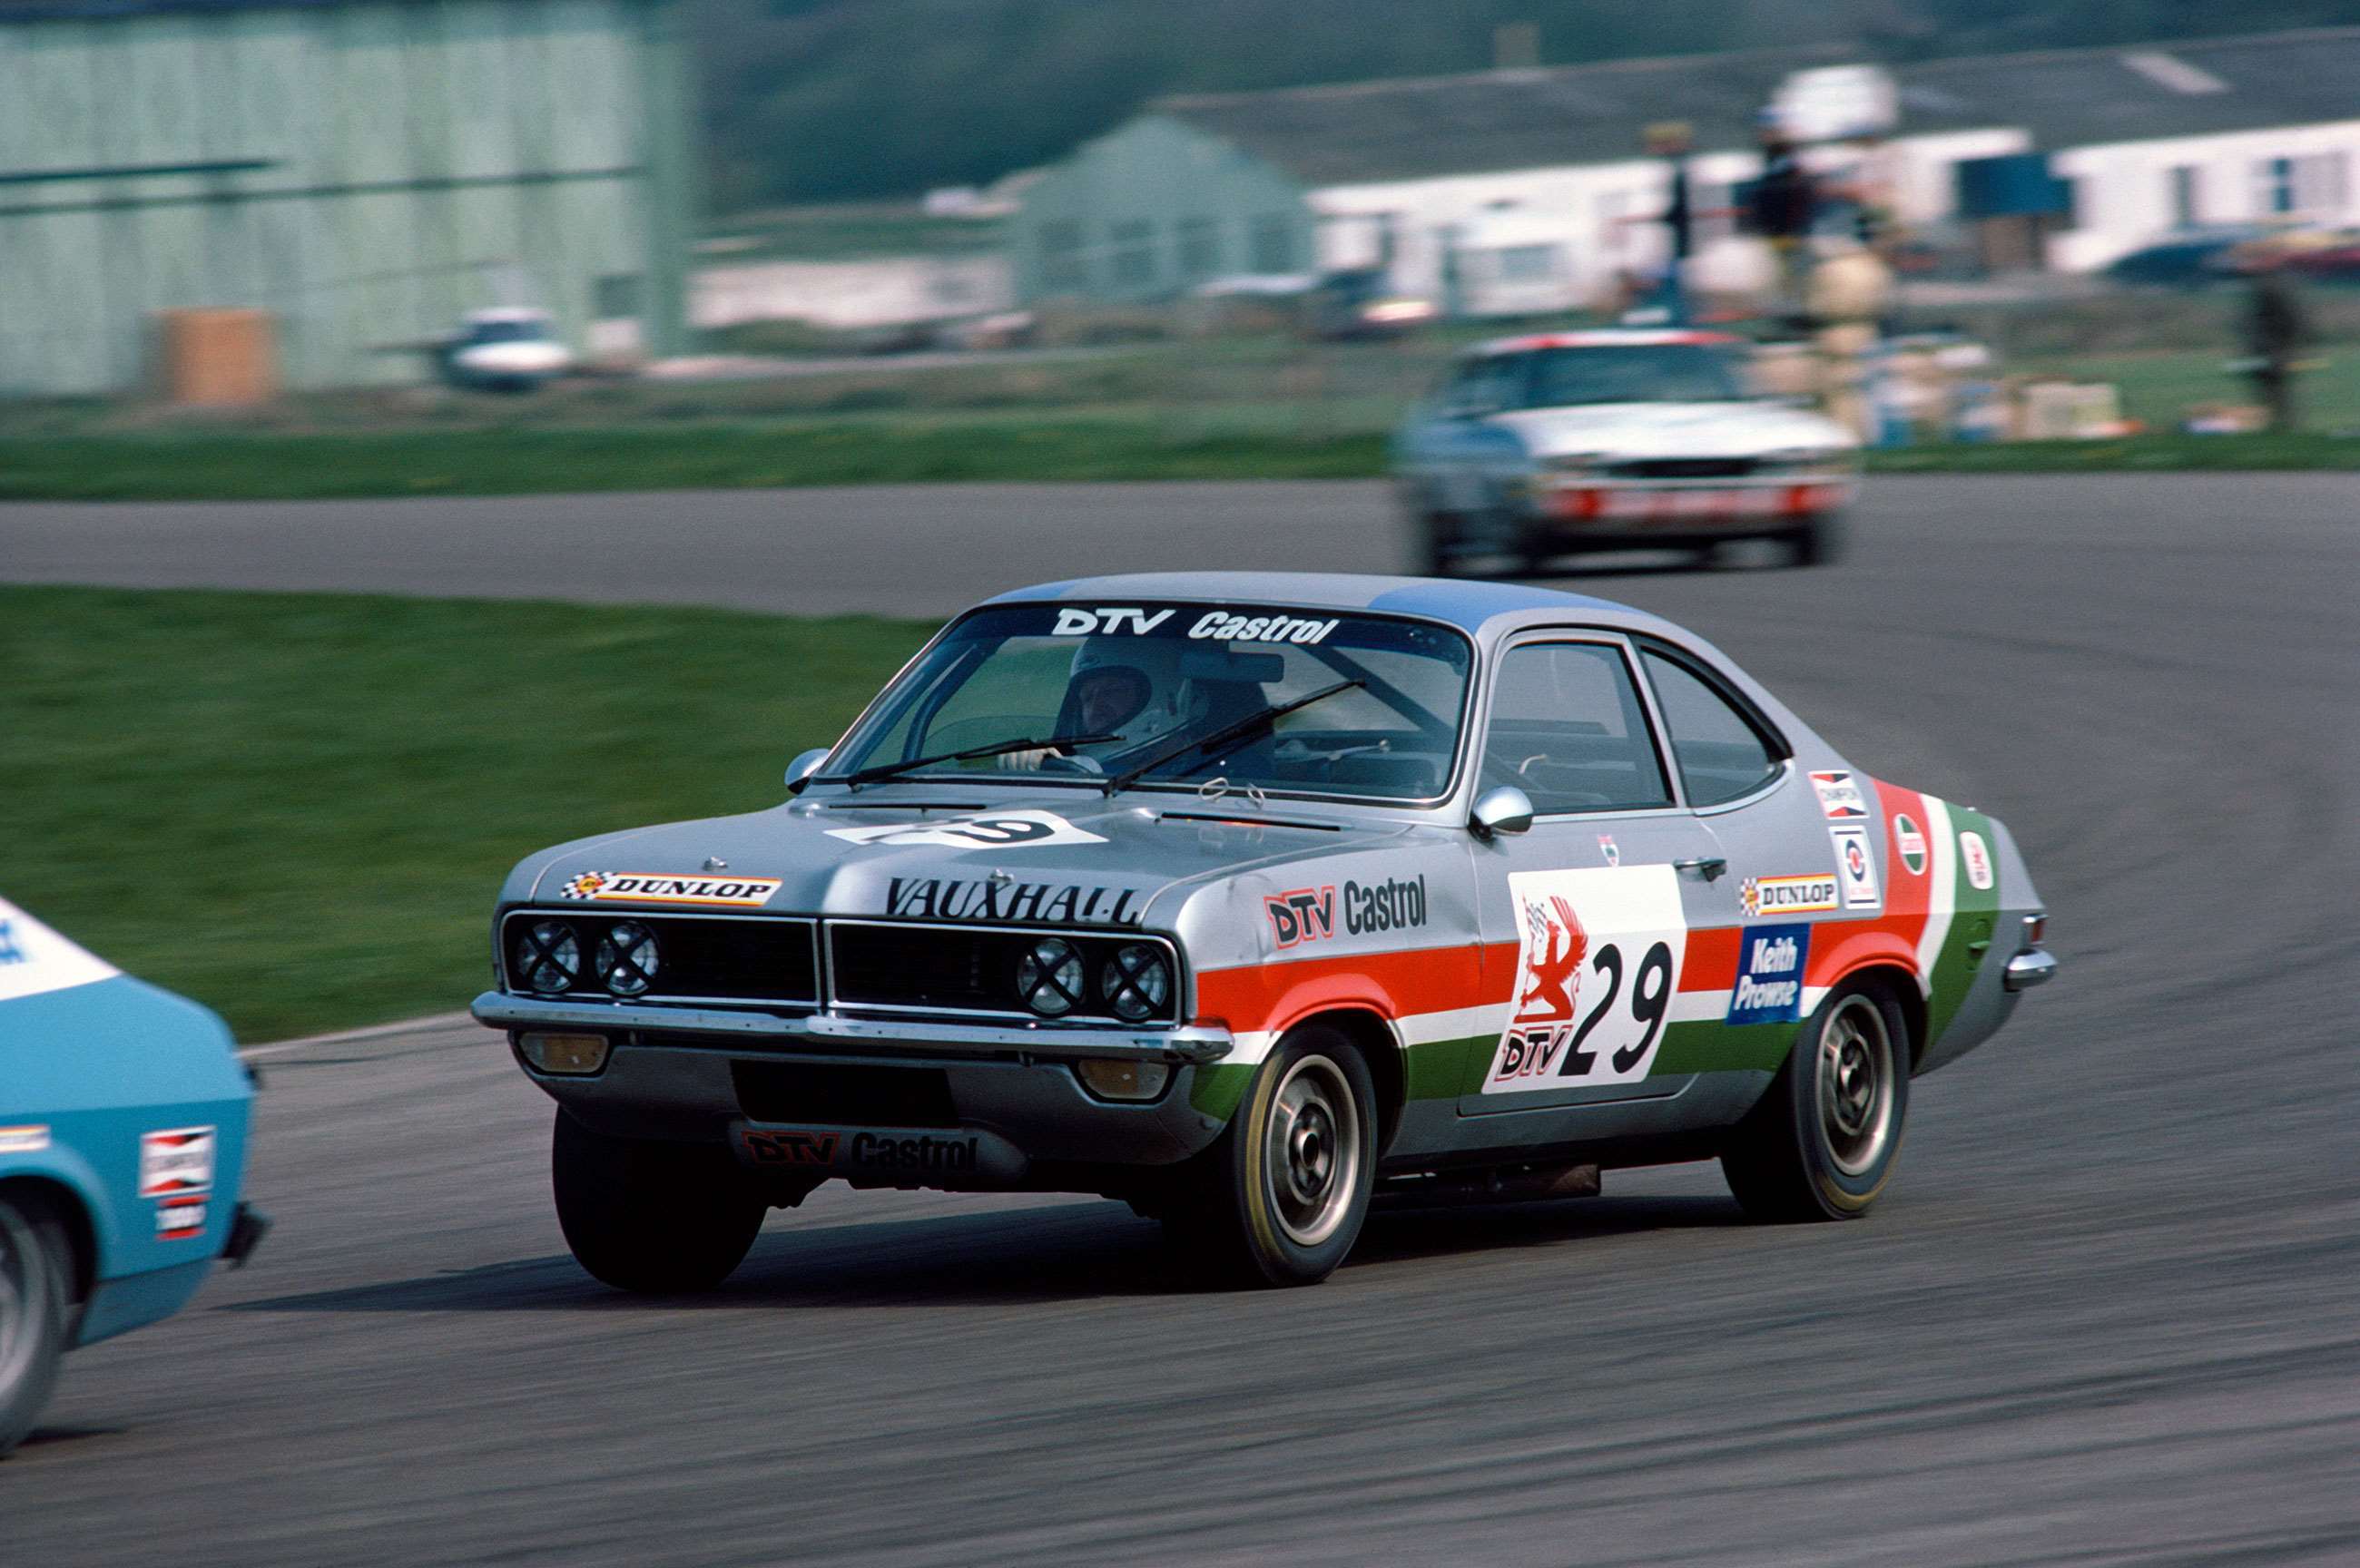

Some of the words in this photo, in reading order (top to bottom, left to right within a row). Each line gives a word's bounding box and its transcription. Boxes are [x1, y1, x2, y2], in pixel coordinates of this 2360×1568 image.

[1052, 608, 1176, 635] DTV
[1187, 611, 1340, 645] Castrol
[609, 878, 772, 899] DUNLOP
[885, 877, 1139, 924] VAUXHALL
[1763, 884, 1834, 906] DUNLOP
[1266, 887, 1334, 946] DTV
[1343, 873, 1427, 936] Castrol
[1749, 936, 1799, 975] Keith
[1558, 940, 1673, 1077] 29
[1733, 975, 1799, 1011] Prowse
[1498, 1027, 1571, 1080] DTV
[743, 1133, 837, 1165] DTV
[851, 1132, 978, 1171] Castrol
